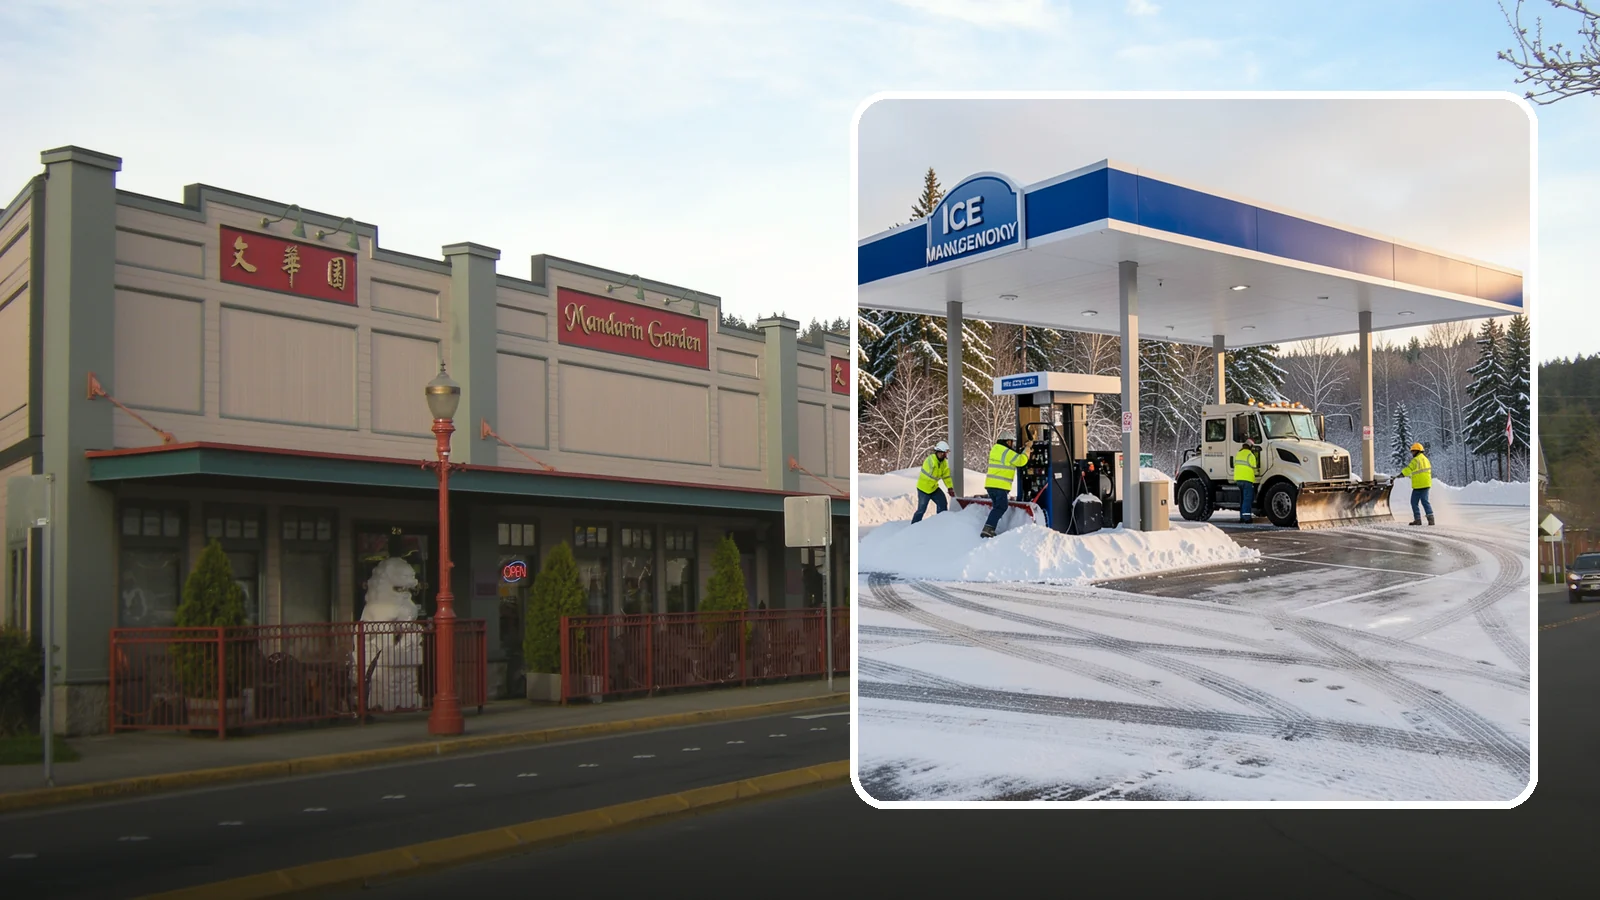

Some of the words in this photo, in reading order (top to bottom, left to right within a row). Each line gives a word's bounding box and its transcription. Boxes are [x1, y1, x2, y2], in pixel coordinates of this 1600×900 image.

[942, 196, 981, 235] ICE
[231, 236, 346, 290] 文華園
[565, 302, 644, 341] Mandarin
[648, 320, 702, 352] Garden
[503, 565, 527, 578] OPEN
